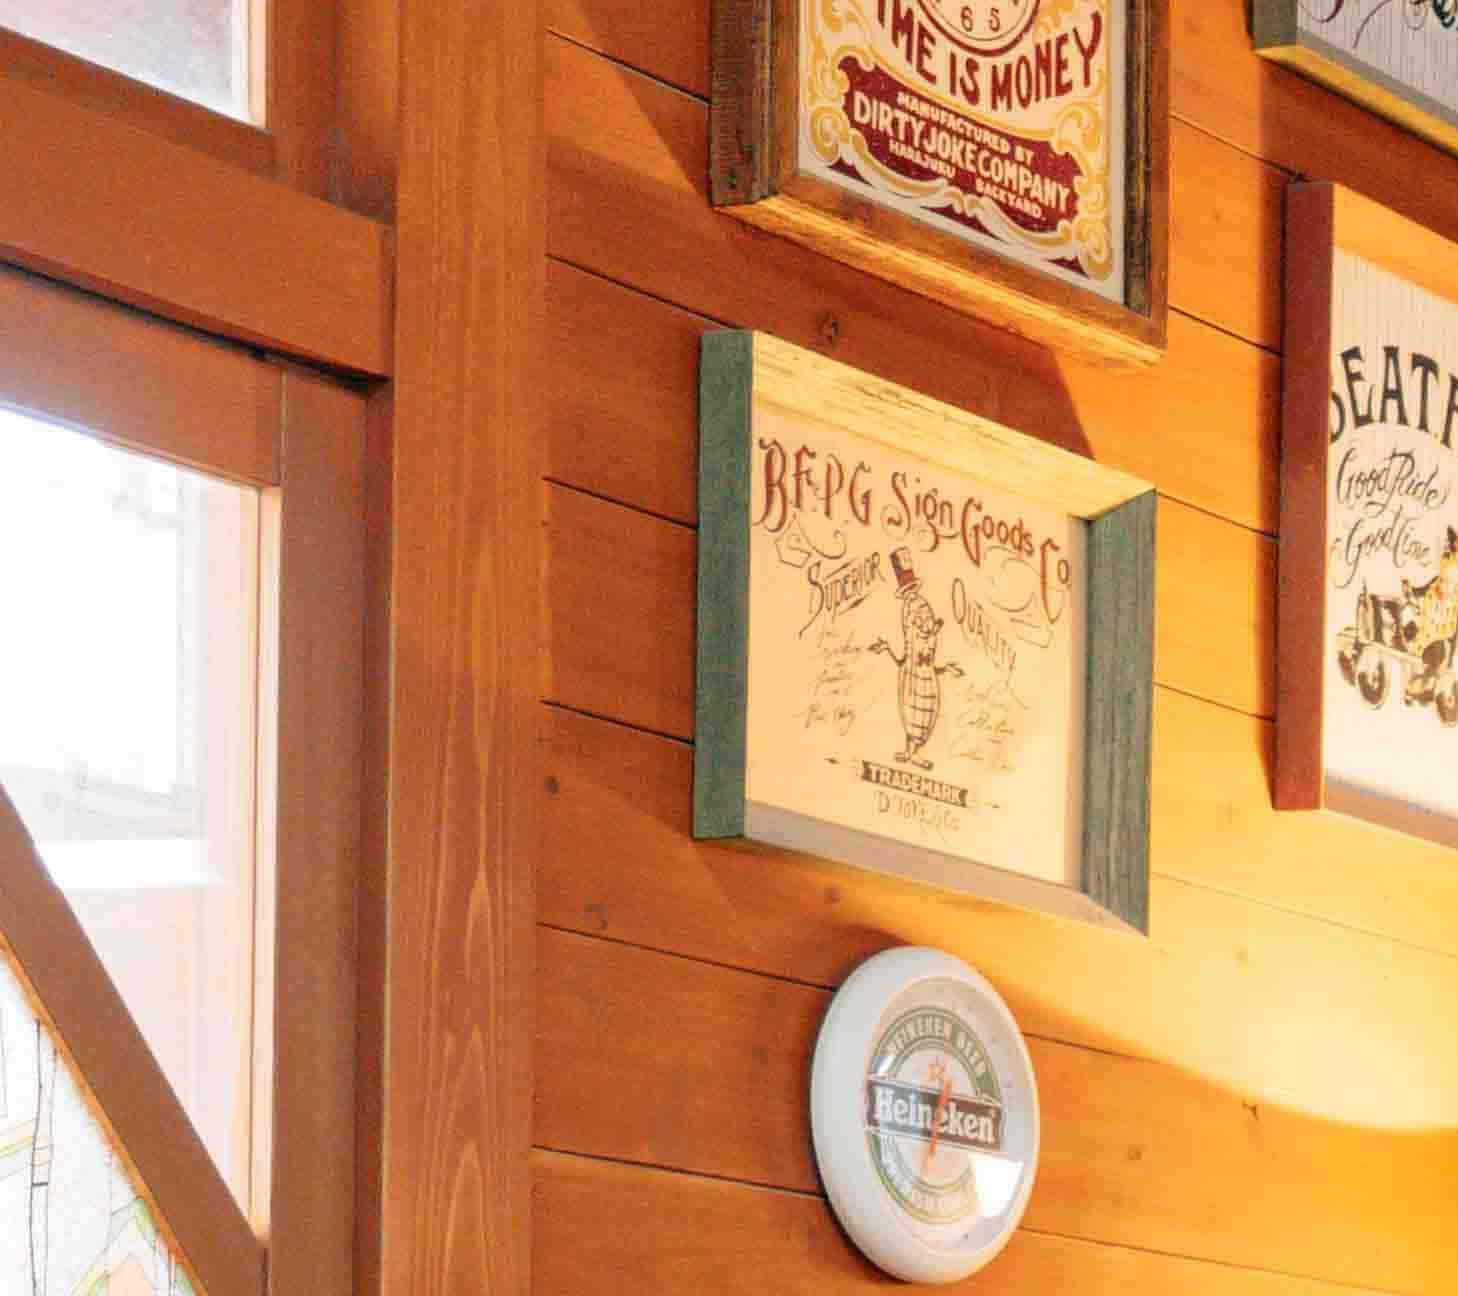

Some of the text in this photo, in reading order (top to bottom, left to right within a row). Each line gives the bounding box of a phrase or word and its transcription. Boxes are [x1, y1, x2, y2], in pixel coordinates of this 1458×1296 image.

[950, 51, 981, 106] IS
[991, 11, 1102, 111] MONEY
[853, 91, 1071, 213] DIRTY JOKE COMPANY
[897, 91, 1036, 168] MANUFACTURED BY
[888, 138, 1042, 219] HARAJUKU BACKYARD
[888, 470, 958, 553] Sign
[961, 497, 1034, 568] Goods
[872, 1087, 996, 1145] Heineken
